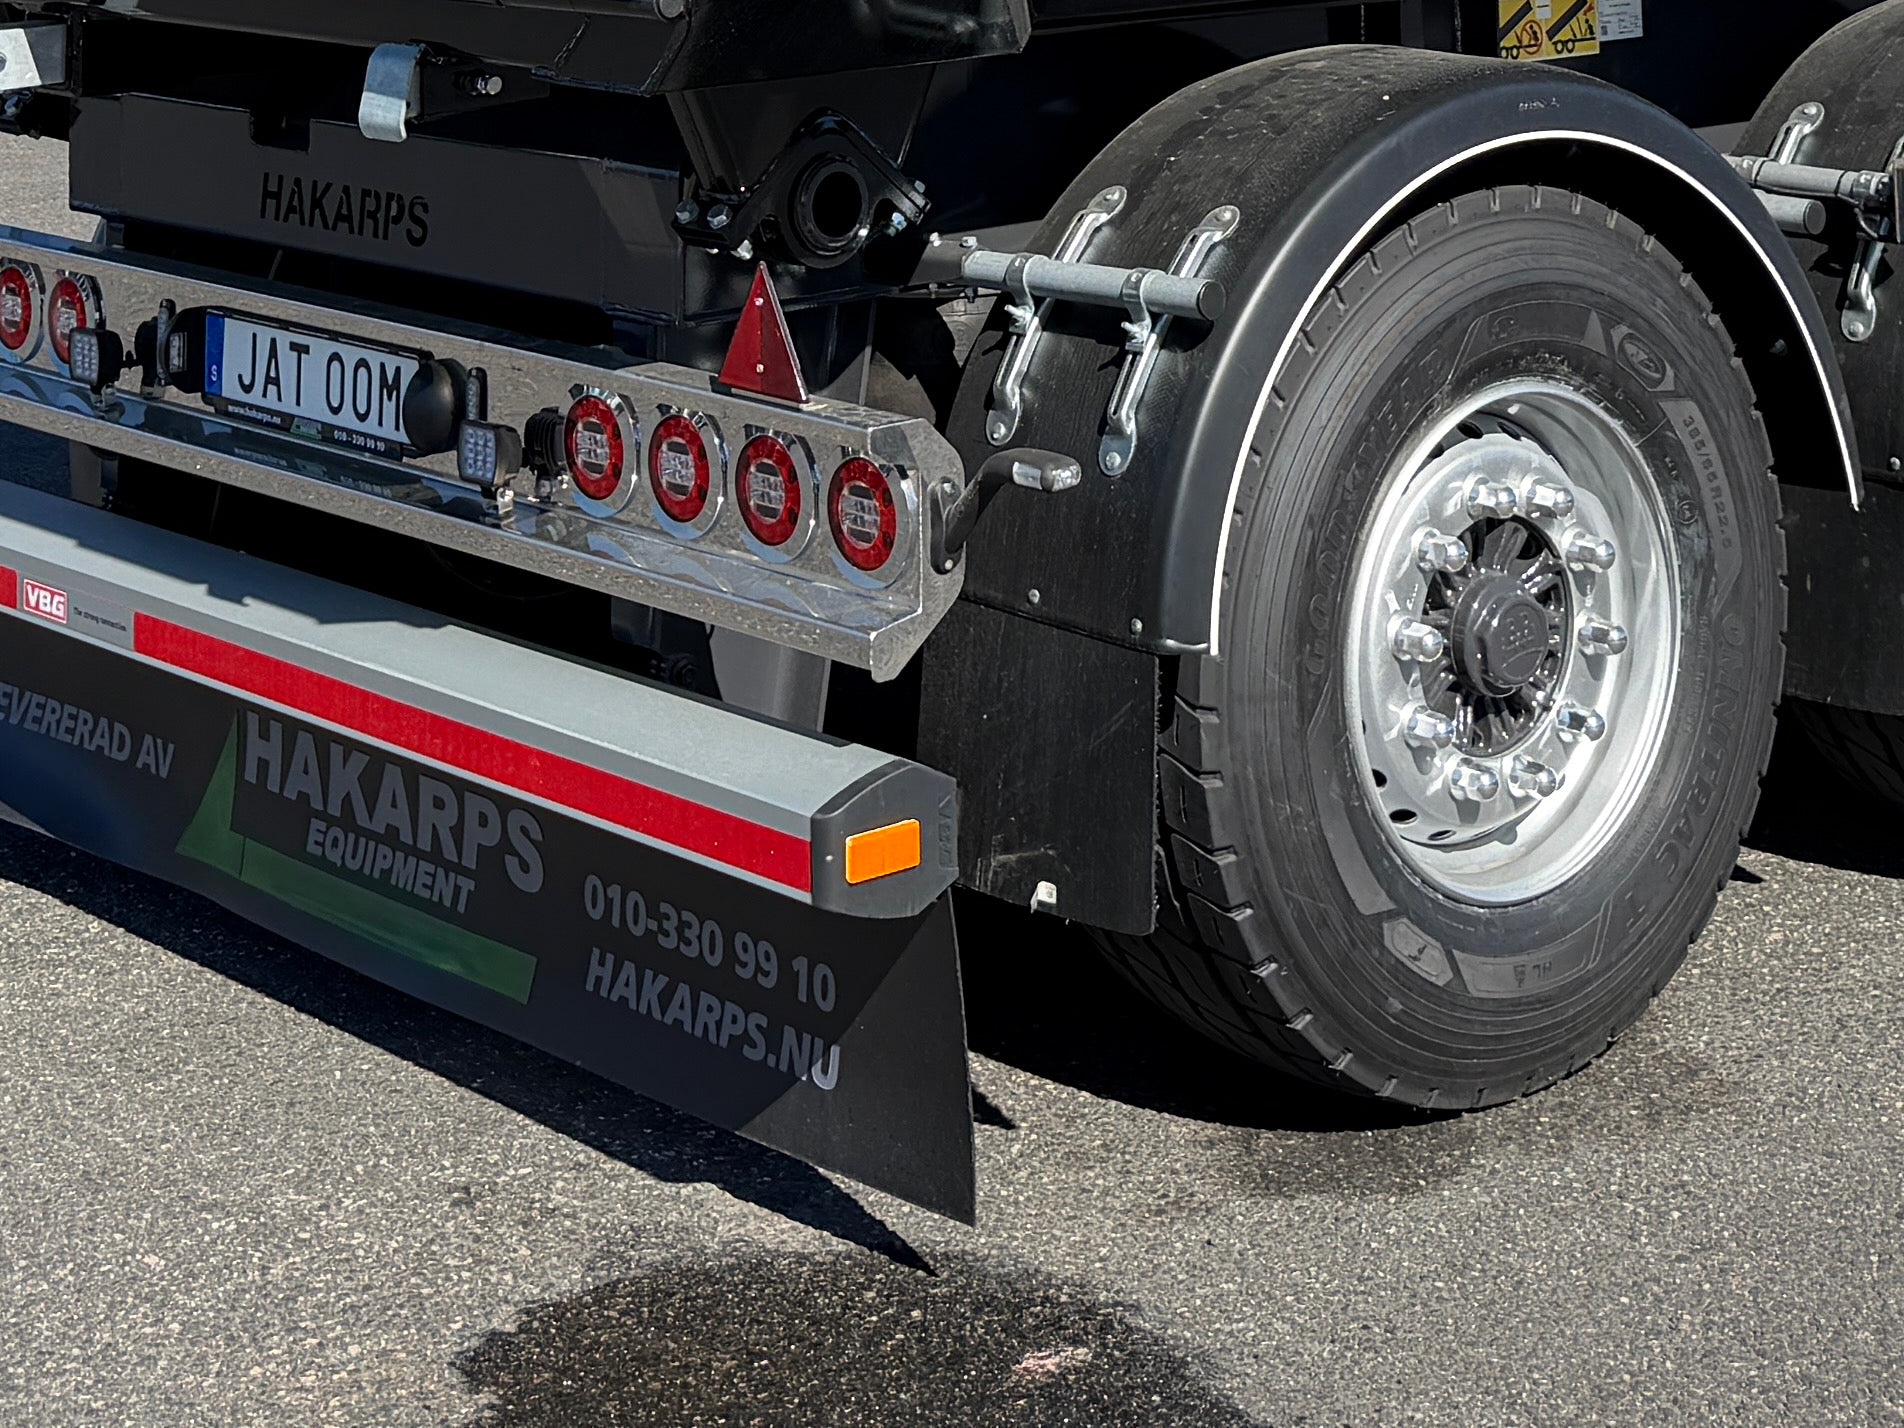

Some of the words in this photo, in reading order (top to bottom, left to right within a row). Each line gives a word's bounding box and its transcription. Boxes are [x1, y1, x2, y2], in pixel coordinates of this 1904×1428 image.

[259, 171, 430, 248] HAKARPS
[237, 332, 310, 407] JAT
[26, 584, 65, 618] VBG
[136, 733, 175, 779] AV
[244, 710, 545, 894] HAKARPS
[306, 817, 476, 914] EQUIPMENT
[584, 874, 723, 968] 010-330
[734, 931, 778, 989] 99
[792, 955, 836, 1013] 10
[585, 947, 840, 1091] HAKARPS.NU
